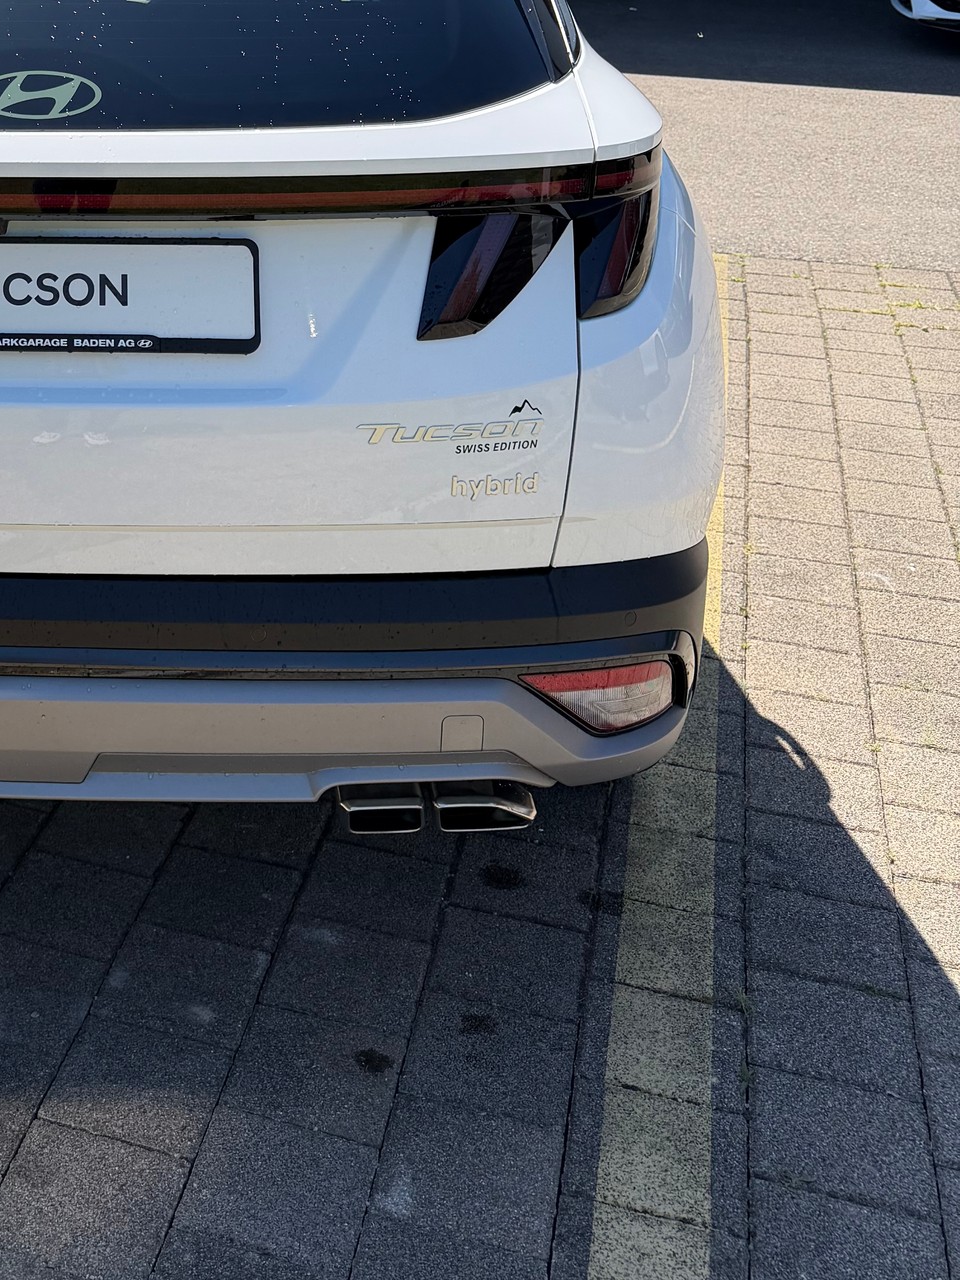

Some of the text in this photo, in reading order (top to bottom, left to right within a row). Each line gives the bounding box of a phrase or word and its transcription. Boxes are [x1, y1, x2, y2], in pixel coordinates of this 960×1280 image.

[73, 338, 115, 348] BADEN
[117, 338, 136, 348] AG
[454, 439, 539, 455] SWISS EDITION
[450, 471, 540, 501] hybrid
